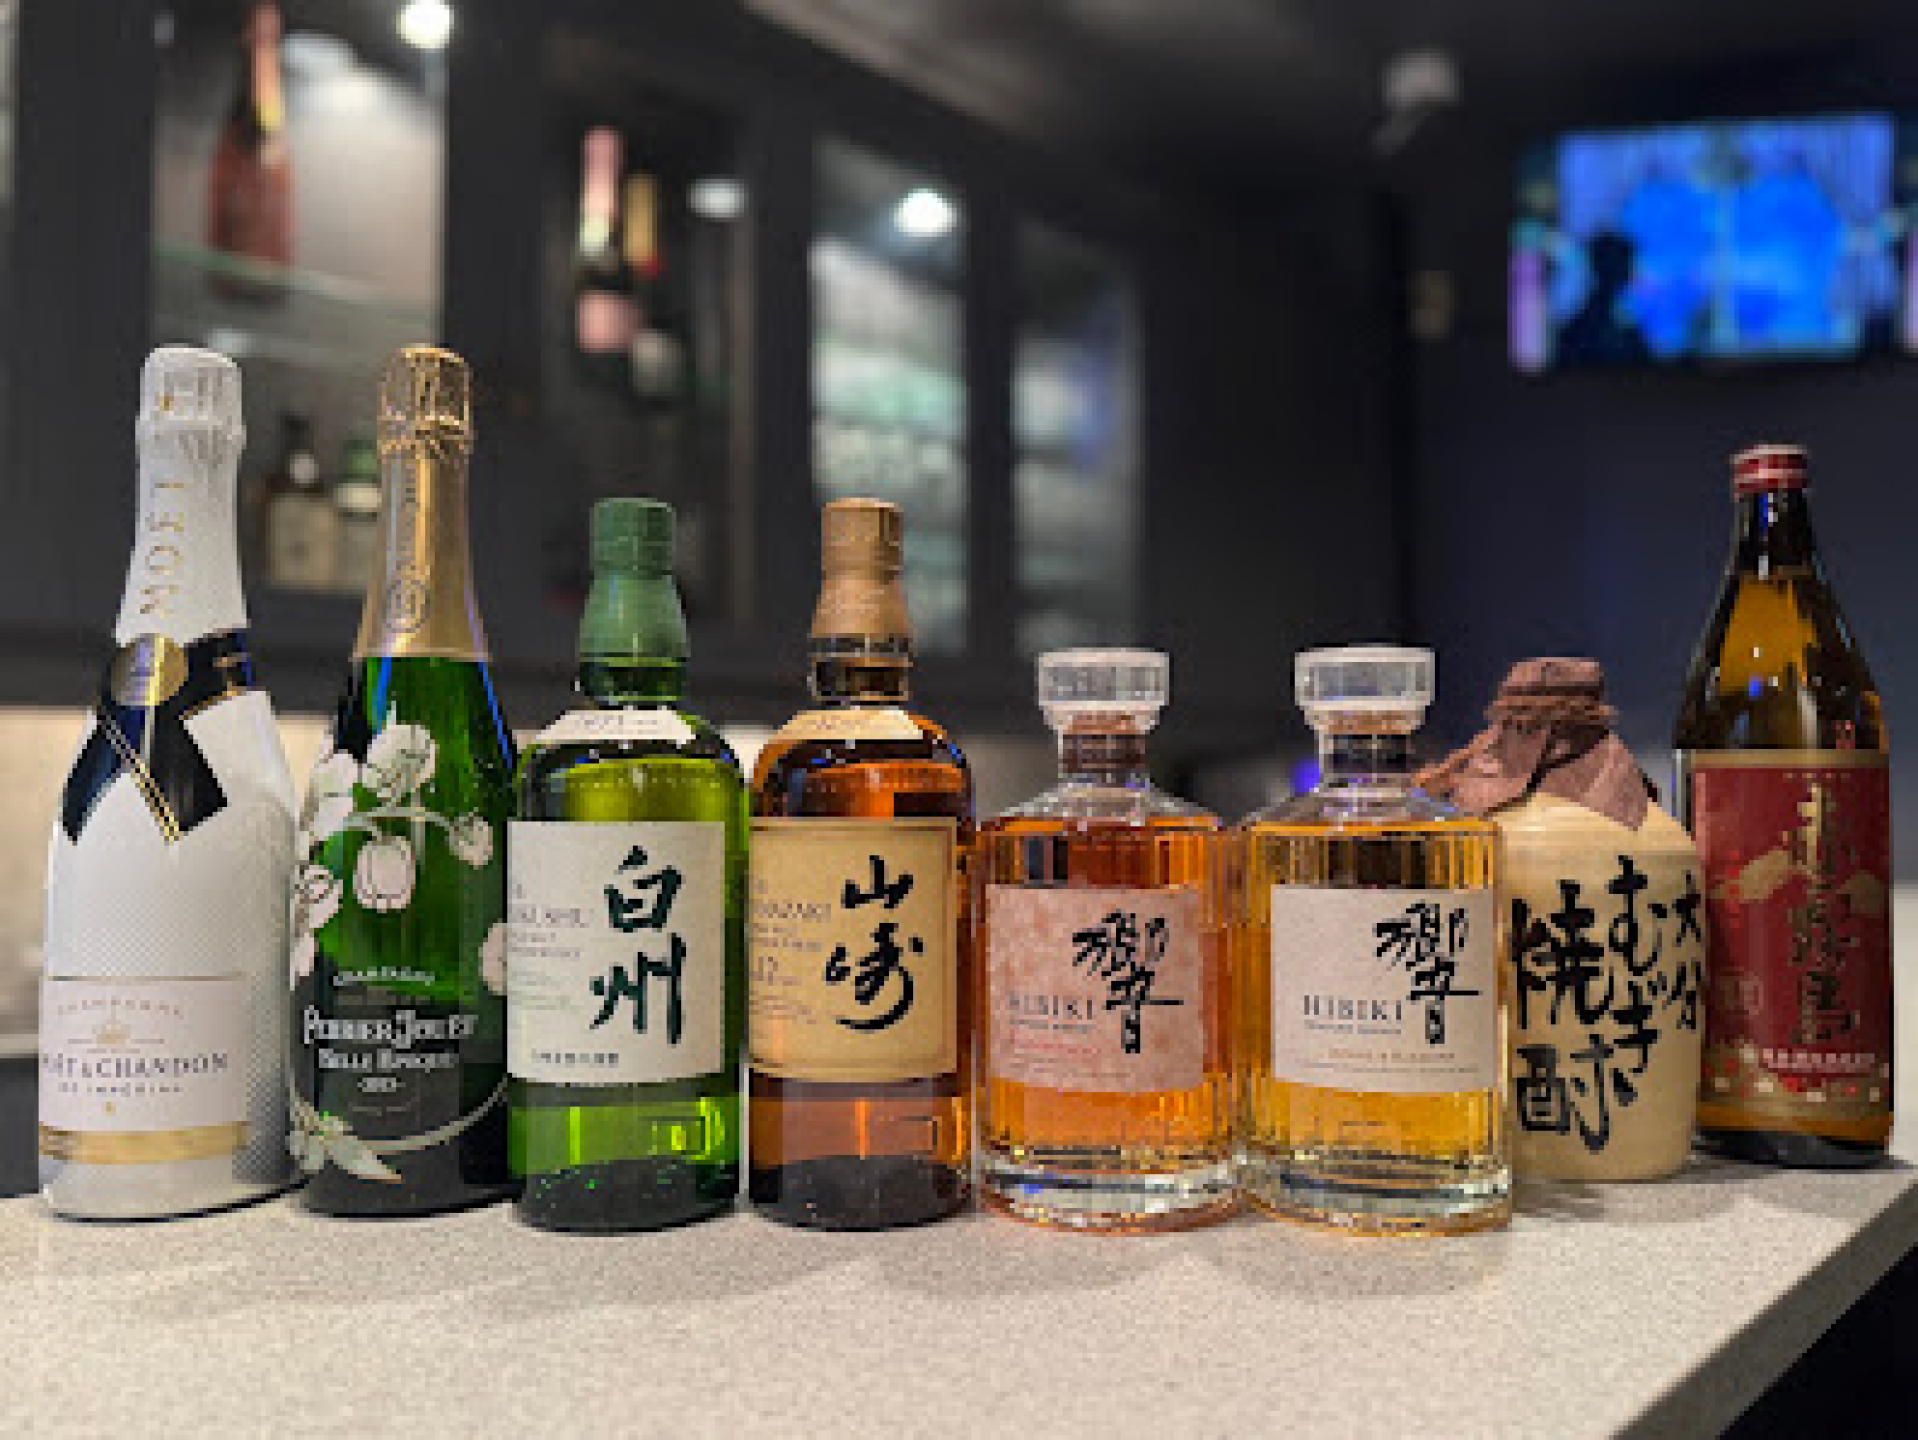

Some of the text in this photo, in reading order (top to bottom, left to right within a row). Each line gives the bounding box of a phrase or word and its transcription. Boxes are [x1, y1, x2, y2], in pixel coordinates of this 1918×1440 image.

[589, 844, 687, 1047] 白州
[823, 854, 926, 1034] 山崎
[1072, 907, 1185, 1054] 響
[1303, 994, 1402, 1021] HIBIKI
[1372, 898, 1484, 1046] 響
